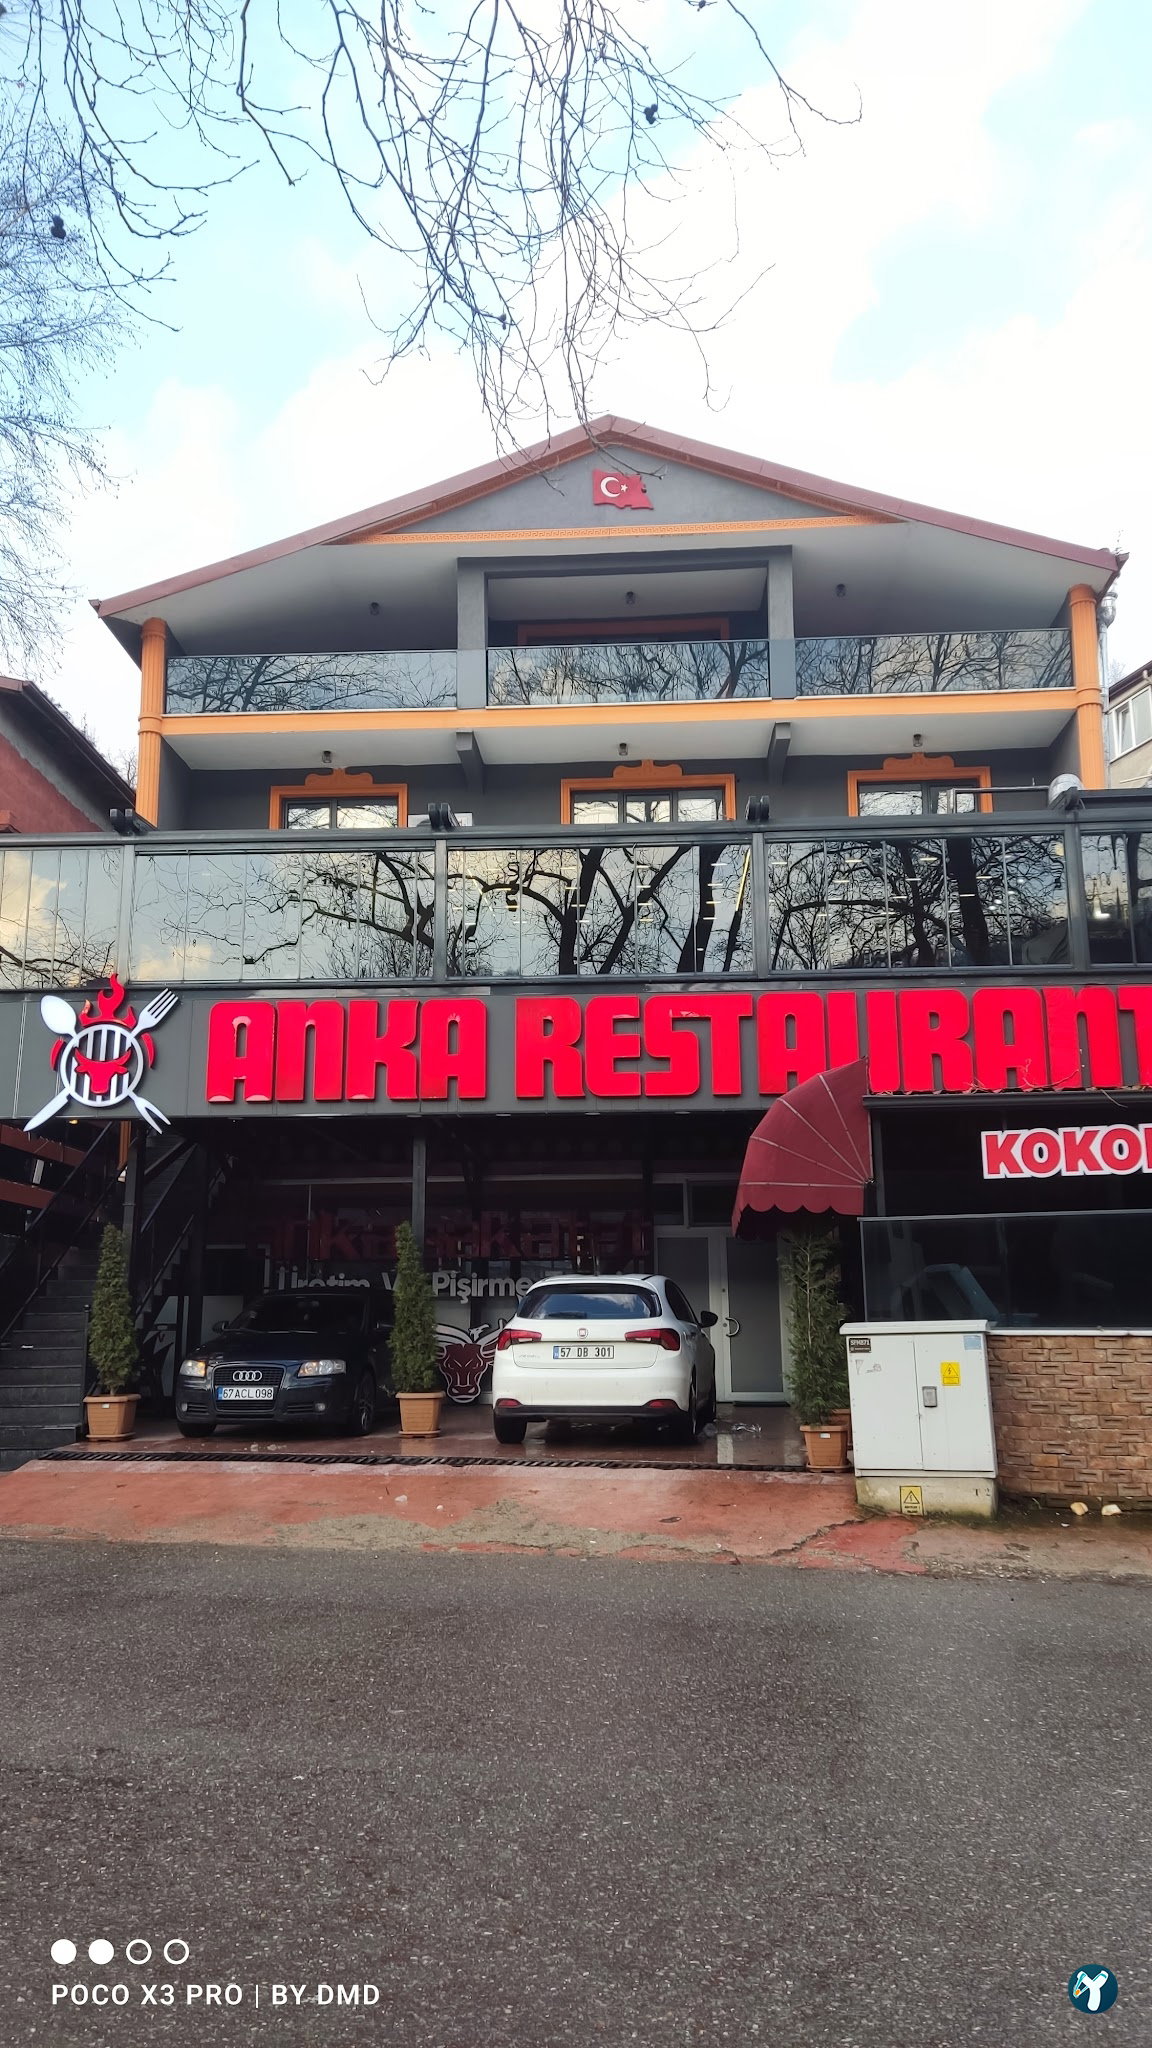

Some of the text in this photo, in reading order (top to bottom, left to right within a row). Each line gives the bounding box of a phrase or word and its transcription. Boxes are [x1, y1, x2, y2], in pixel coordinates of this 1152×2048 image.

[206, 998, 487, 1102] ANKA
[981, 1123, 1152, 1180] KOKO
[432, 1271, 533, 1305] Pişirme
[560, 1347, 571, 1358] 57
[577, 1347, 589, 1358] DB
[594, 1347, 611, 1358] 301
